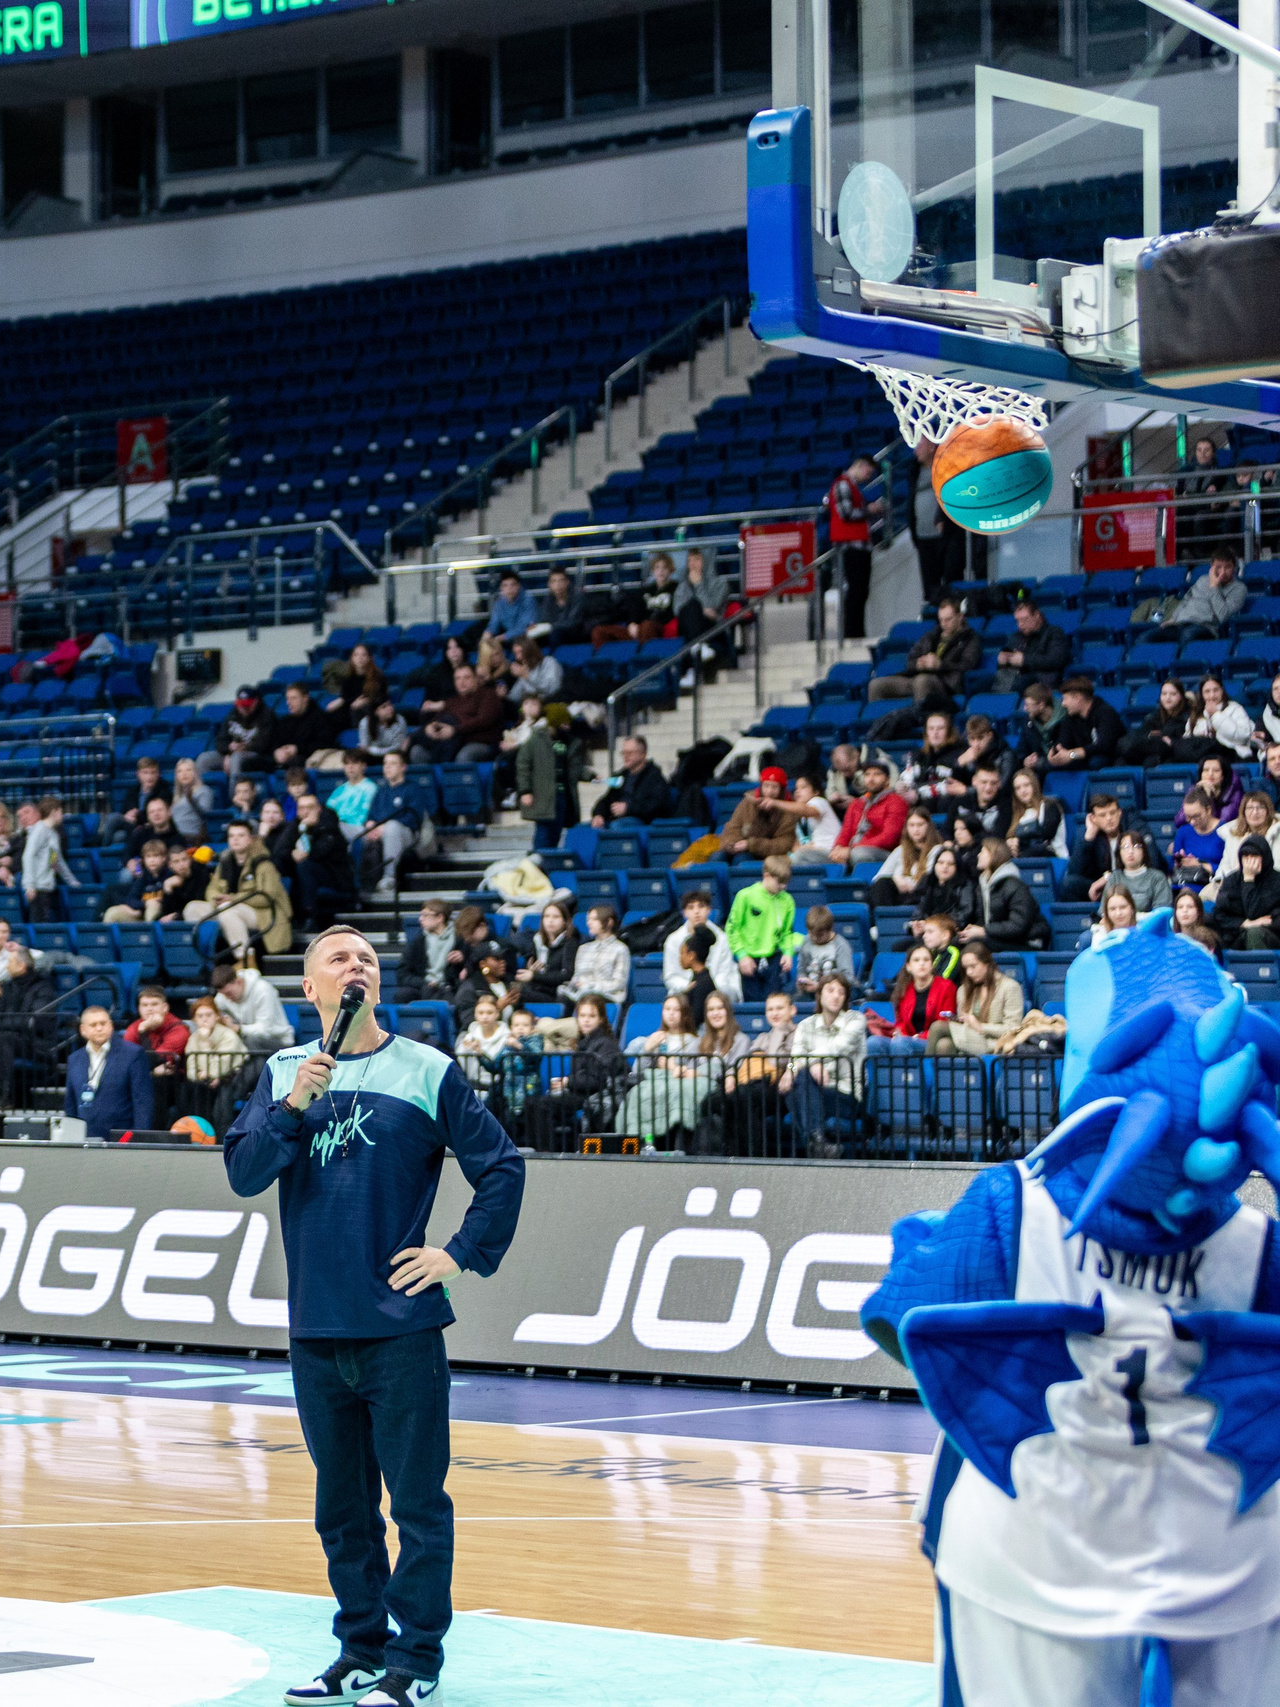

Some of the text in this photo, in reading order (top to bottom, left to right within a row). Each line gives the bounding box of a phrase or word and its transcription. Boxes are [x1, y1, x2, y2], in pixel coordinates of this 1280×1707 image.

[127, 432, 155, 473] A
[1095, 514, 1115, 540] G
[513, 1186, 893, 1361] JÖG
[1116, 1347, 1150, 1446] 1
